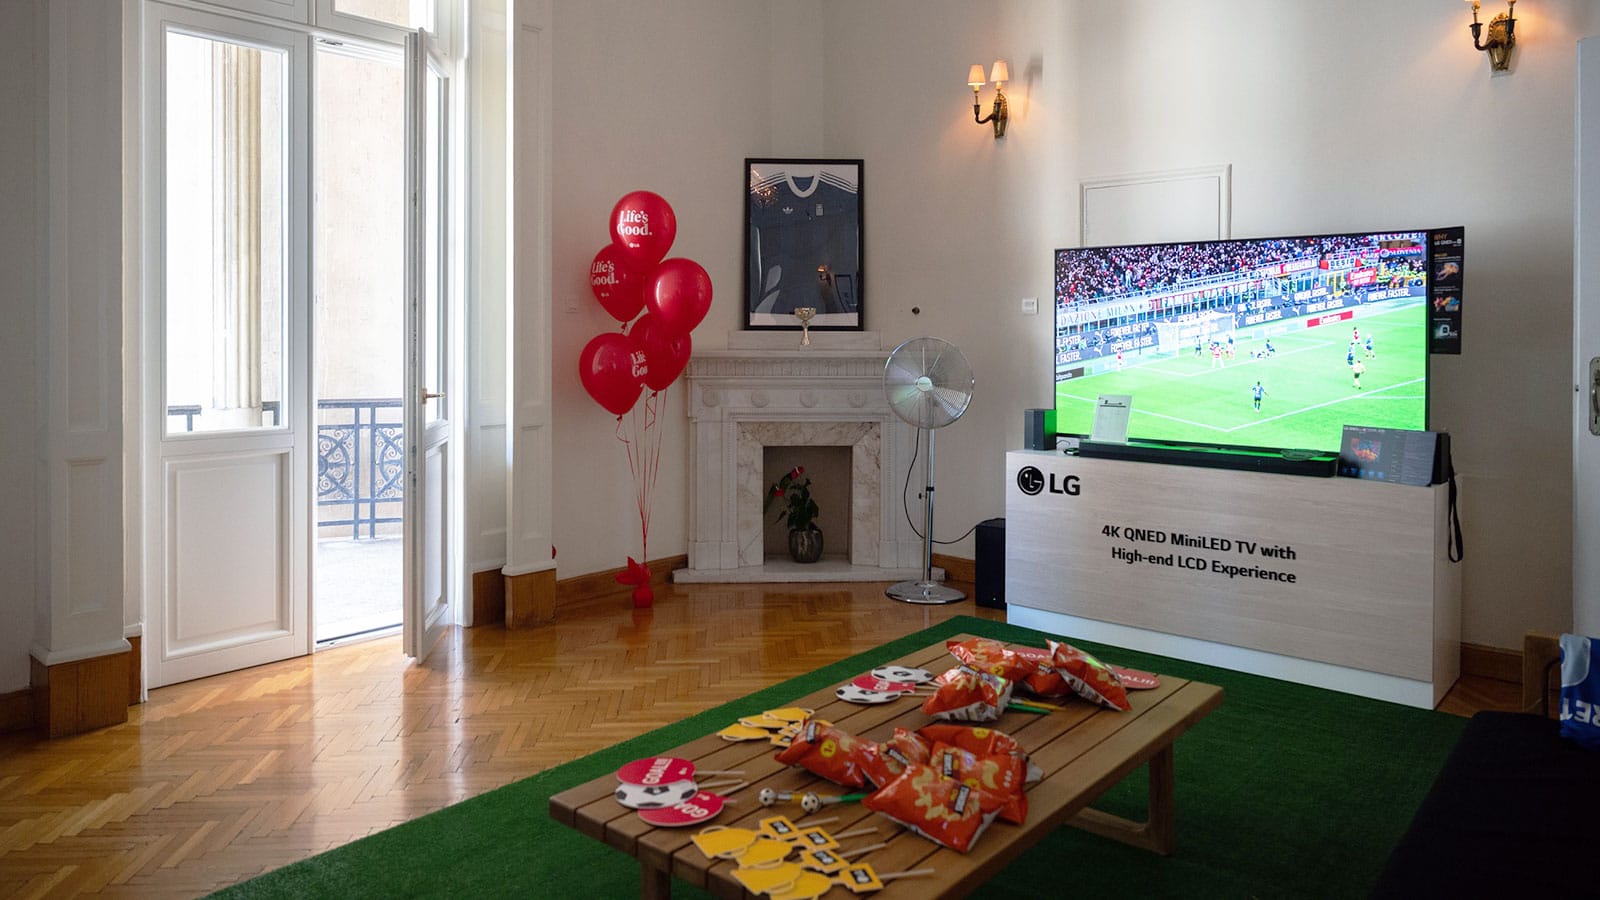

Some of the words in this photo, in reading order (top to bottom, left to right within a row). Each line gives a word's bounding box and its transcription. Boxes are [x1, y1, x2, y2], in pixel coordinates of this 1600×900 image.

[620, 209, 649, 224] Life's
[617, 223, 653, 236] Good.
[592, 260, 615, 273] Life's
[1049, 473, 1081, 496] LG
[1101, 525, 1121, 539] 4K
[1123, 527, 1167, 544] QNED
[1170, 533, 1232, 552] MiniLED
[1235, 540, 1257, 555] TV
[1260, 545, 1297, 560] with
[1111, 547, 1174, 567] High-end
[1178, 555, 1207, 571] LCD
[1211, 560, 1297, 583] Experience
